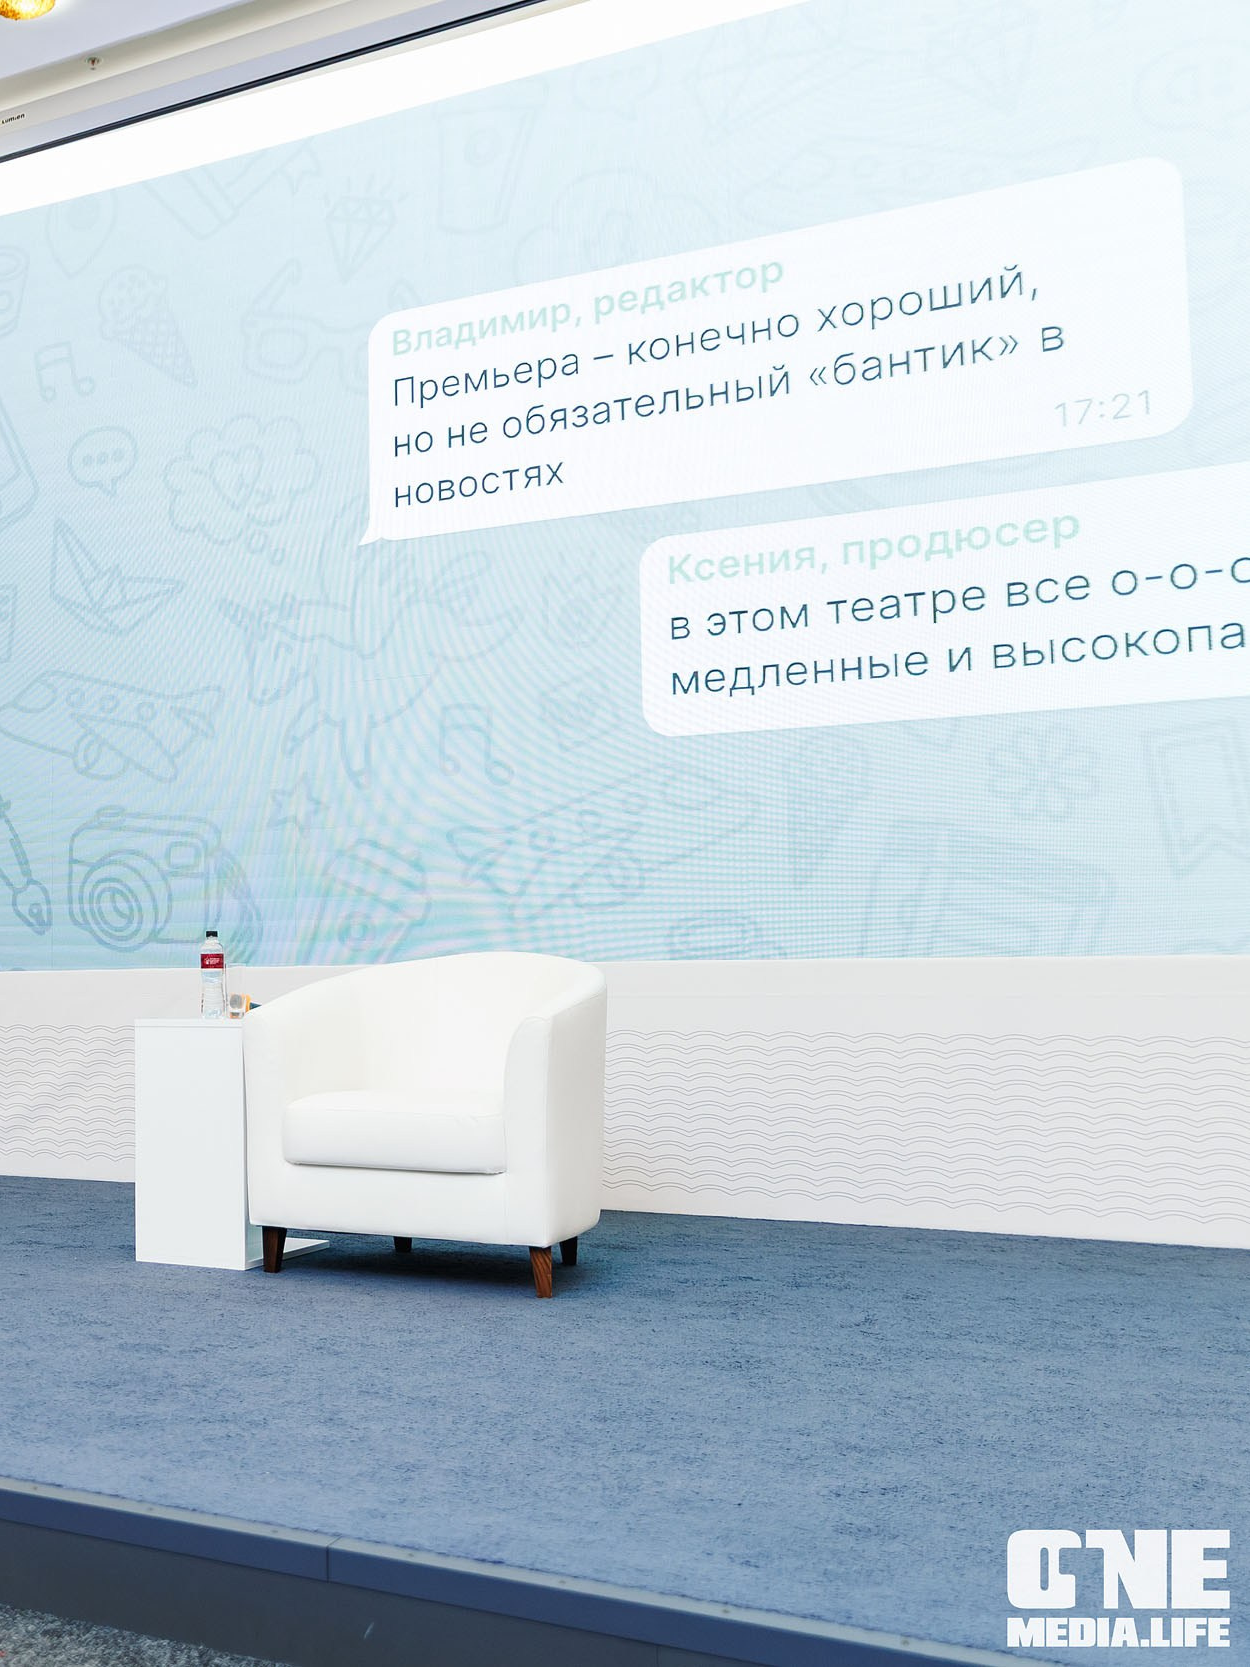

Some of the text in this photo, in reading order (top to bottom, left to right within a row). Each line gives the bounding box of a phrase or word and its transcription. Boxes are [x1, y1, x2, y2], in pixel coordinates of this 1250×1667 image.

[391, 262, 783, 356] Владимир, редактор
[393, 353, 580, 408] Премьера
[627, 314, 800, 366] конечно
[816, 264, 1038, 332] хороший,
[393, 325, 1065, 457] но не обязательный «бантик» в
[1053, 389, 1151, 428] 17:21
[393, 461, 565, 508] новостях
[668, 515, 1081, 585] Ксения, продюсер
[670, 616, 691, 640] в
[706, 603, 809, 637] этом
[826, 585, 986, 624] театре
[1006, 574, 1091, 607] все
[671, 621, 1246, 697] медленные и высокопа
